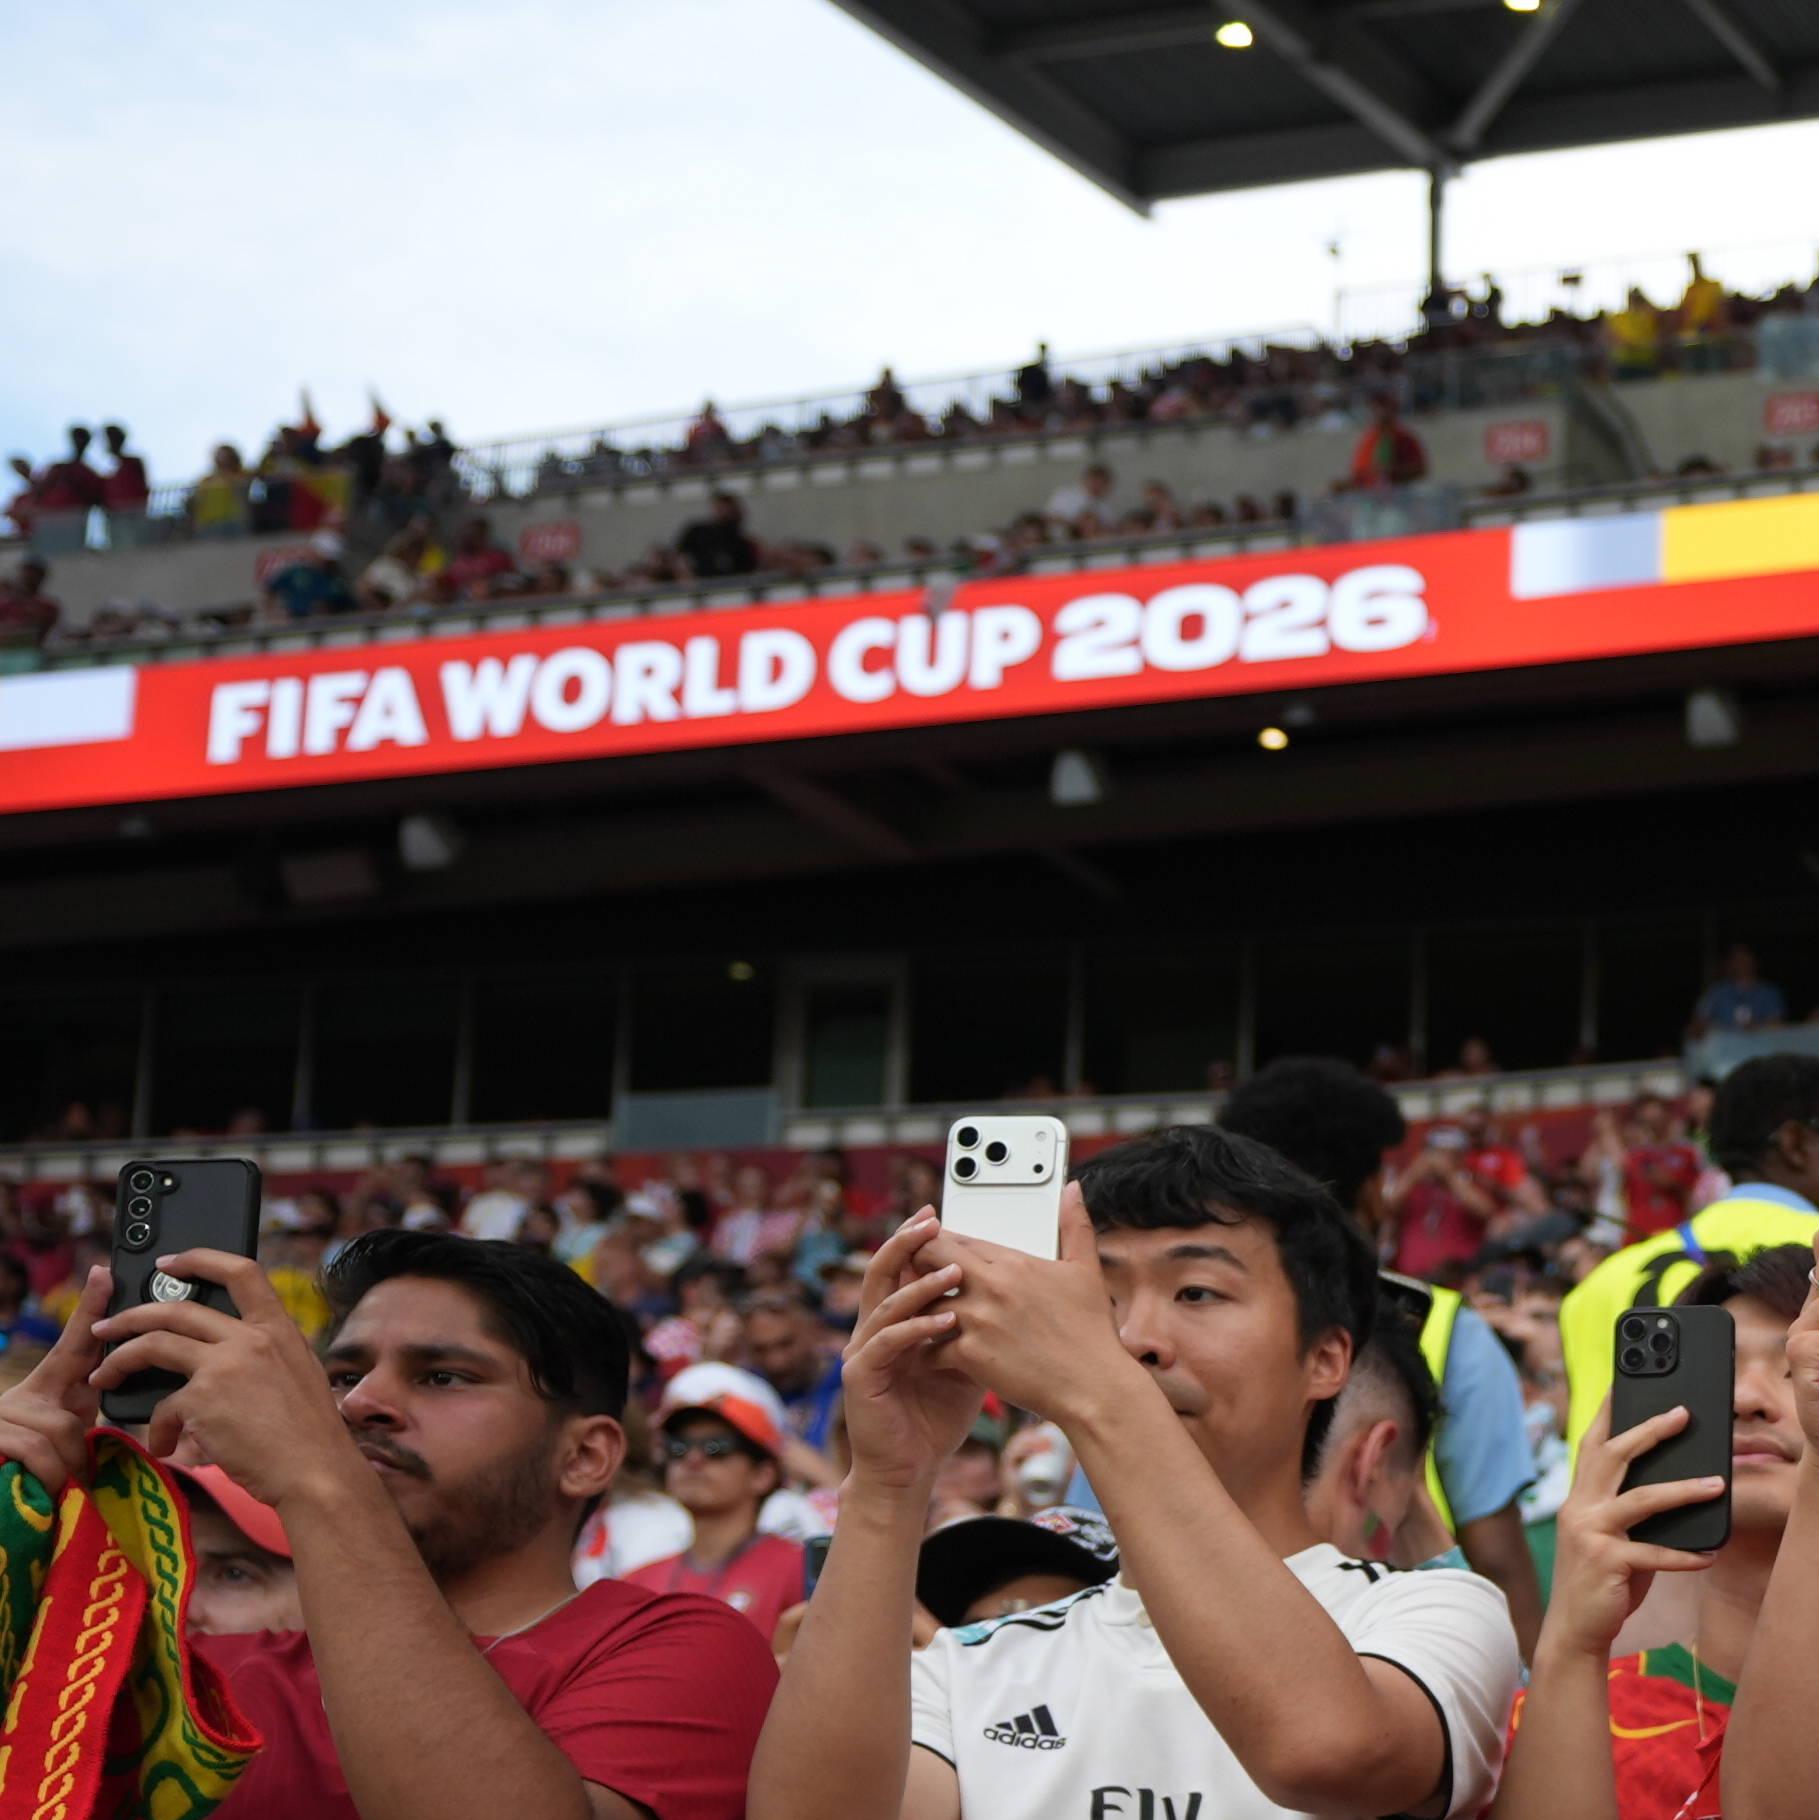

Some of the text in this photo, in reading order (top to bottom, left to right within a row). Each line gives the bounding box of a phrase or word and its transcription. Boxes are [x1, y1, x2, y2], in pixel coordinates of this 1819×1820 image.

[208, 566, 1426, 763] FIFA WORLD CUP 2026
[983, 1726, 1067, 1750] adidas
